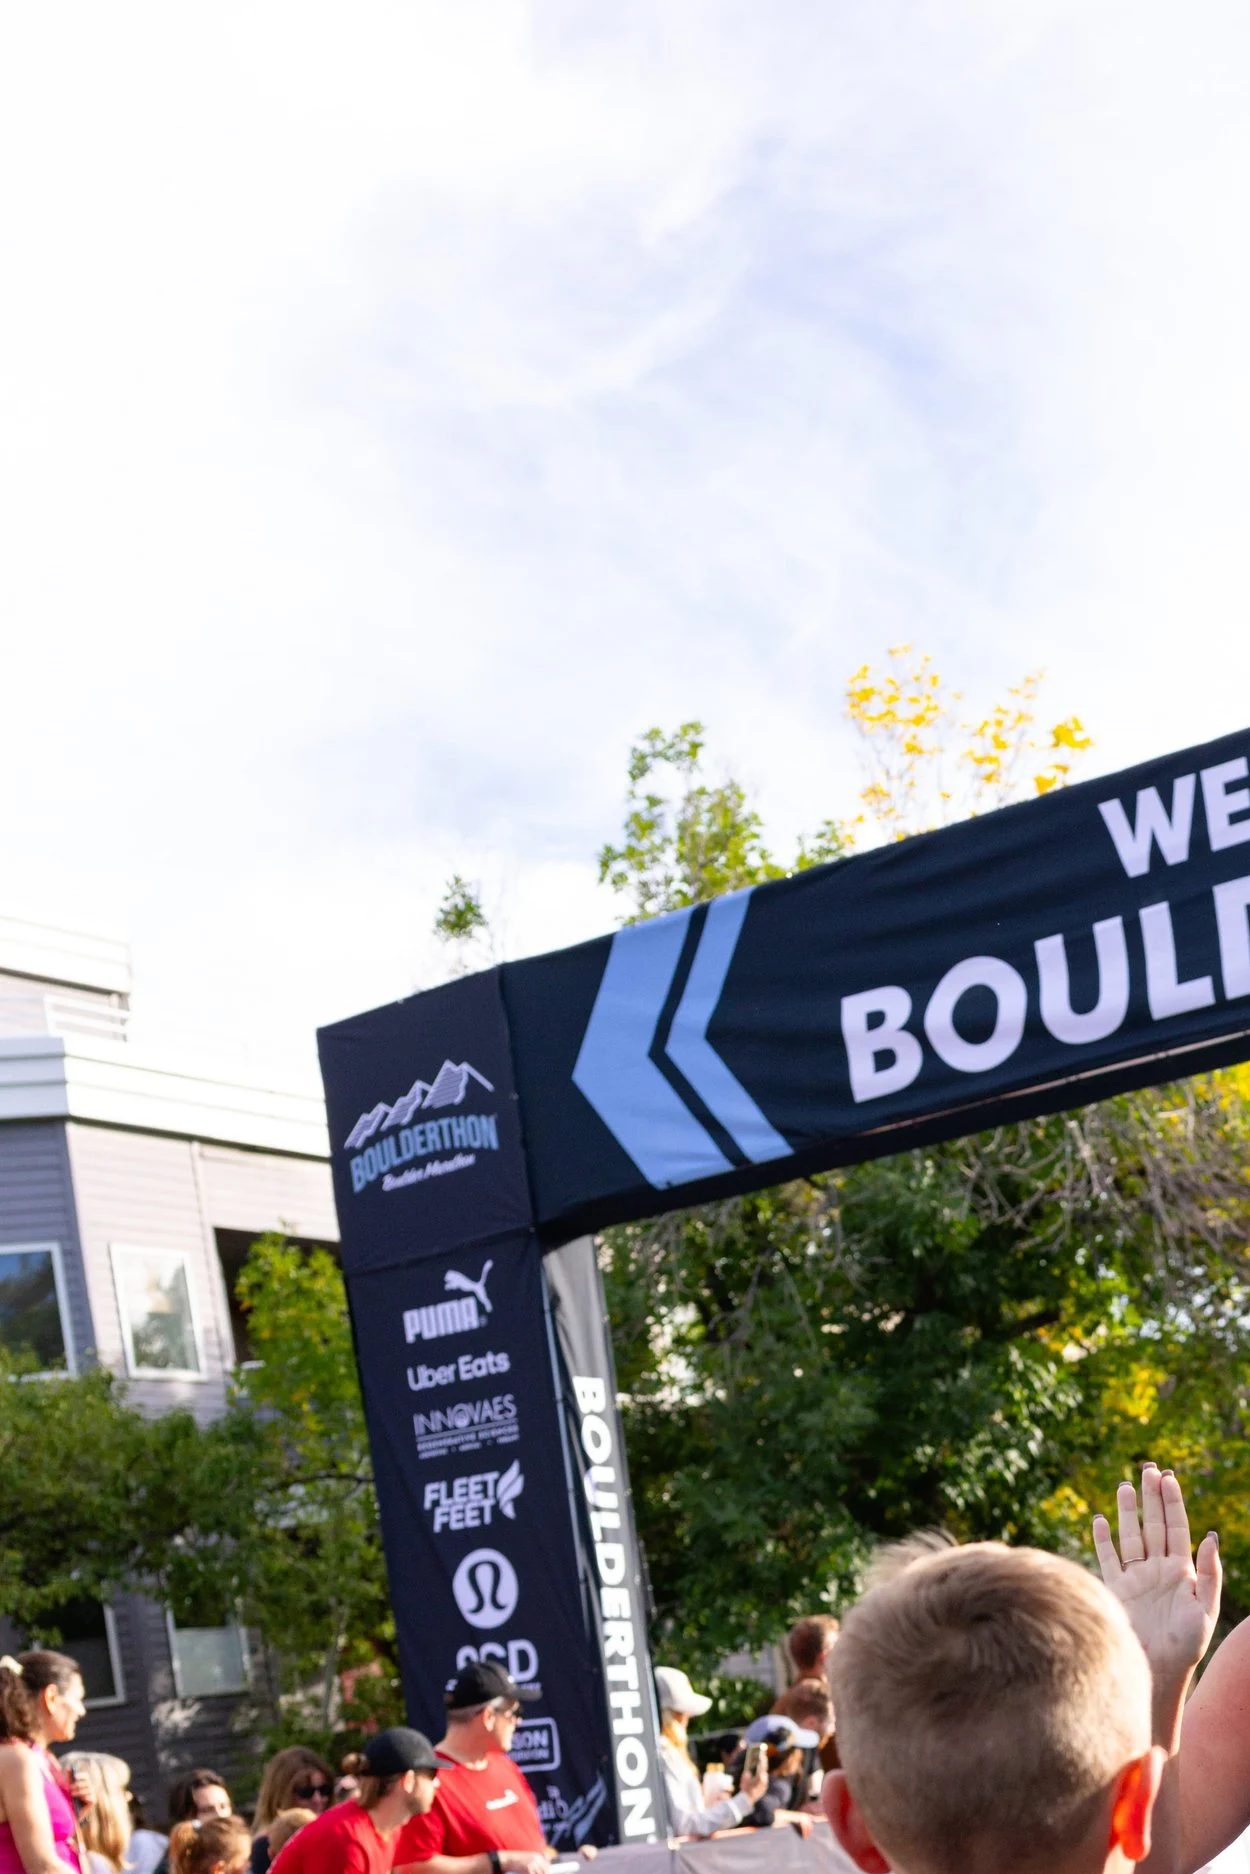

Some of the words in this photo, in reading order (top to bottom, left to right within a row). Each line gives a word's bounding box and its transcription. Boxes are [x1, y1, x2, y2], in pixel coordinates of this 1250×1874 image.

[350, 1114, 499, 1193] BOULDERTHON
[403, 1296, 480, 1344] PUMA
[406, 1363, 457, 1392] Uber
[457, 1351, 511, 1381] Eats
[413, 1394, 518, 1437] INNOVAES
[424, 1471, 500, 1510] FLEET
[433, 1499, 496, 1533] FEET
[572, 1375, 656, 1837] BOULDERTHON
